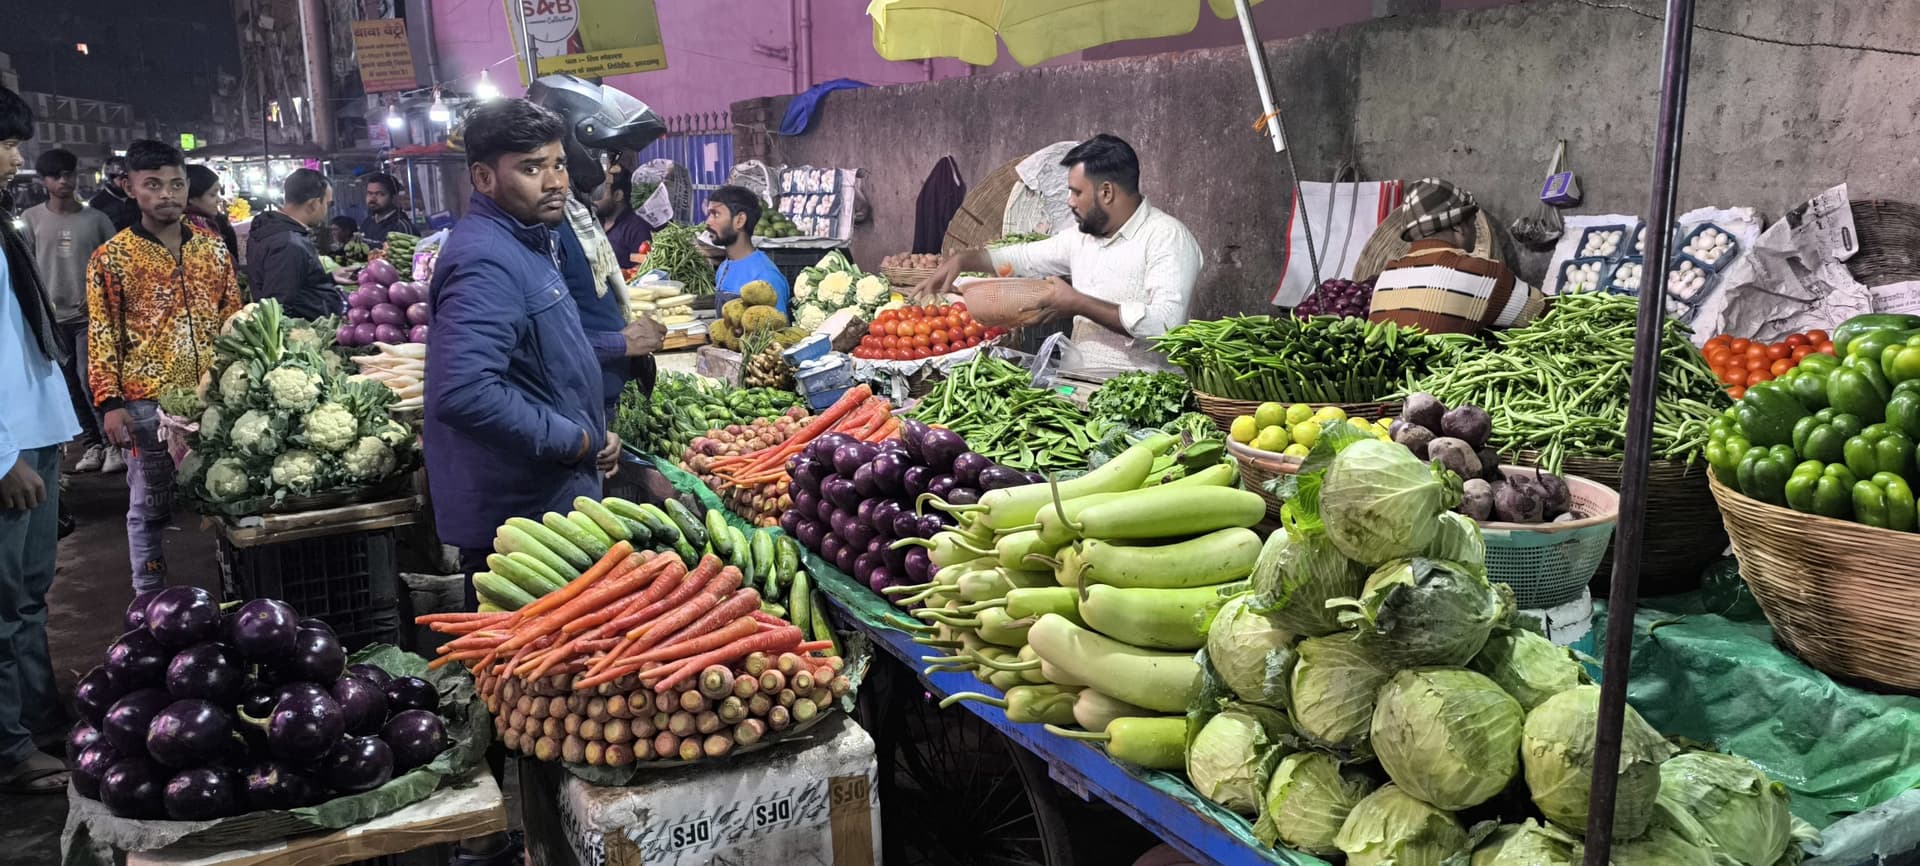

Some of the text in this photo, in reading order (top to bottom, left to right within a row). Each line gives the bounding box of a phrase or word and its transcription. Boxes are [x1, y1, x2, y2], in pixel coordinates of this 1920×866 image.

[833, 780, 865, 806] DFS
[755, 799, 790, 826] DFS
[673, 820, 709, 848] DFS
